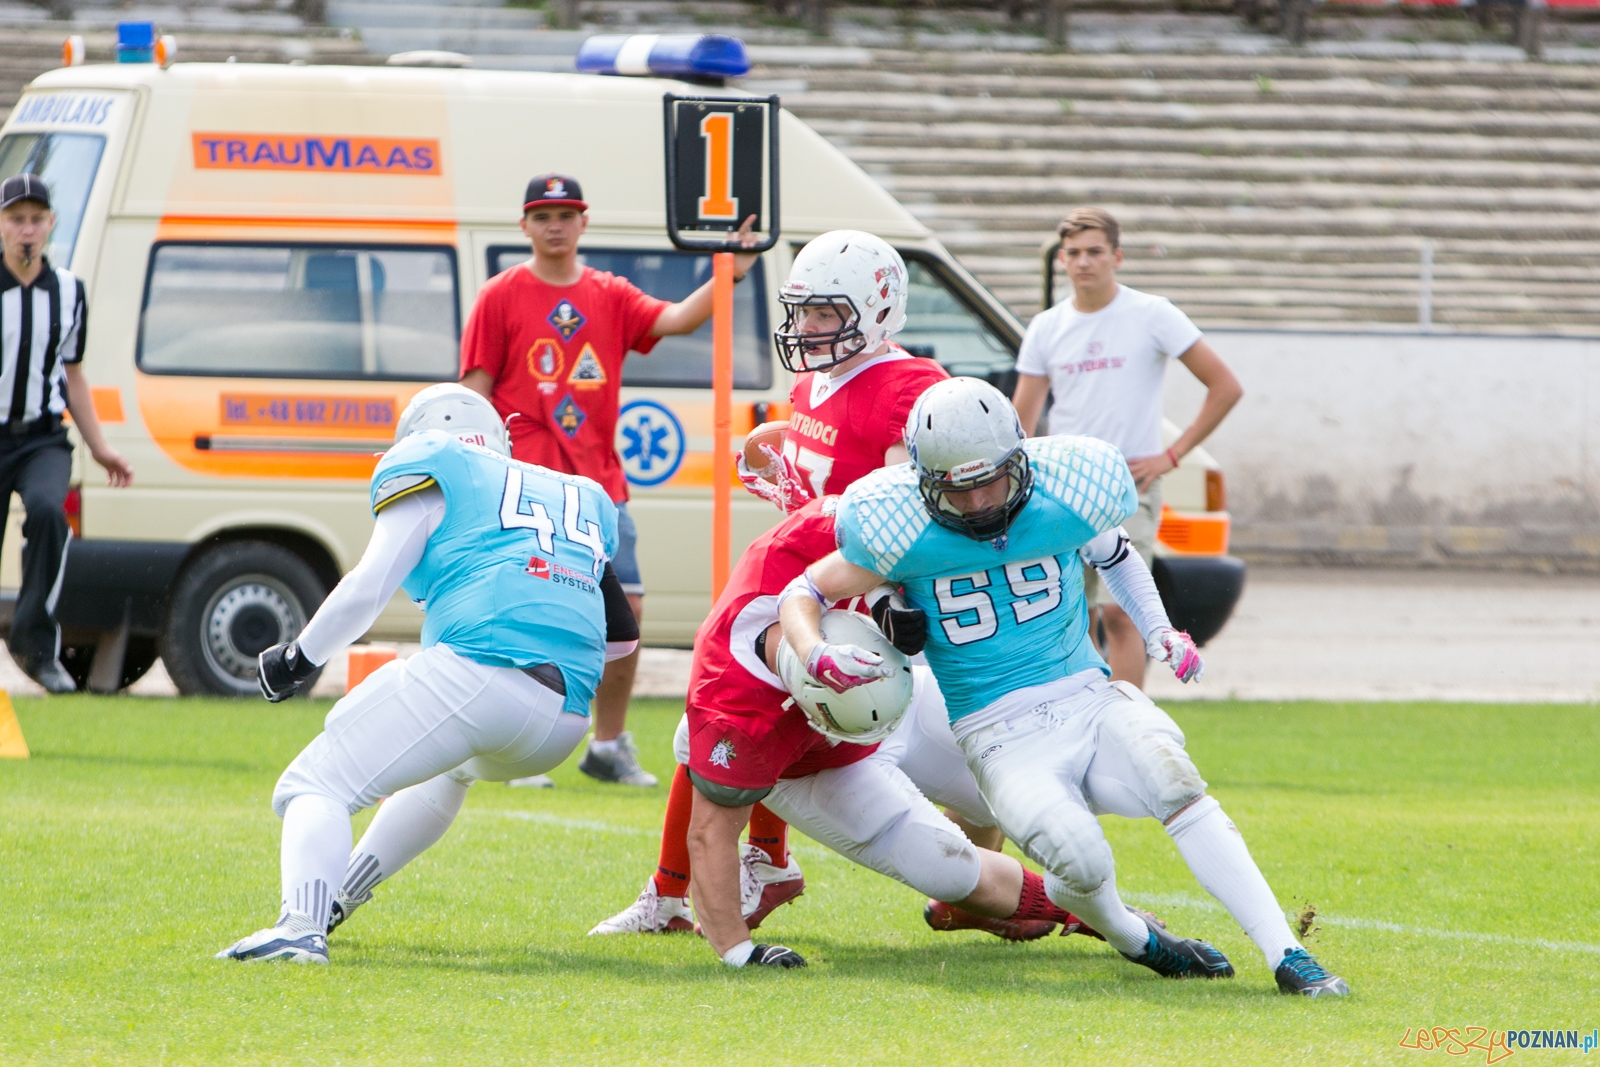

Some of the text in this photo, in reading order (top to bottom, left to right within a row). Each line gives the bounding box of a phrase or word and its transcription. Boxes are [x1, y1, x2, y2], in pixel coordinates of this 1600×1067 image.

[14, 96, 115, 125] AMBULANS
[201, 138, 434, 171] TRAUMAAS
[698, 111, 739, 220] 1
[789, 411, 839, 447] ATRIOCI
[498, 466, 608, 577] 44
[552, 573, 597, 596] SYSTEM
[933, 555, 1063, 646] 59
